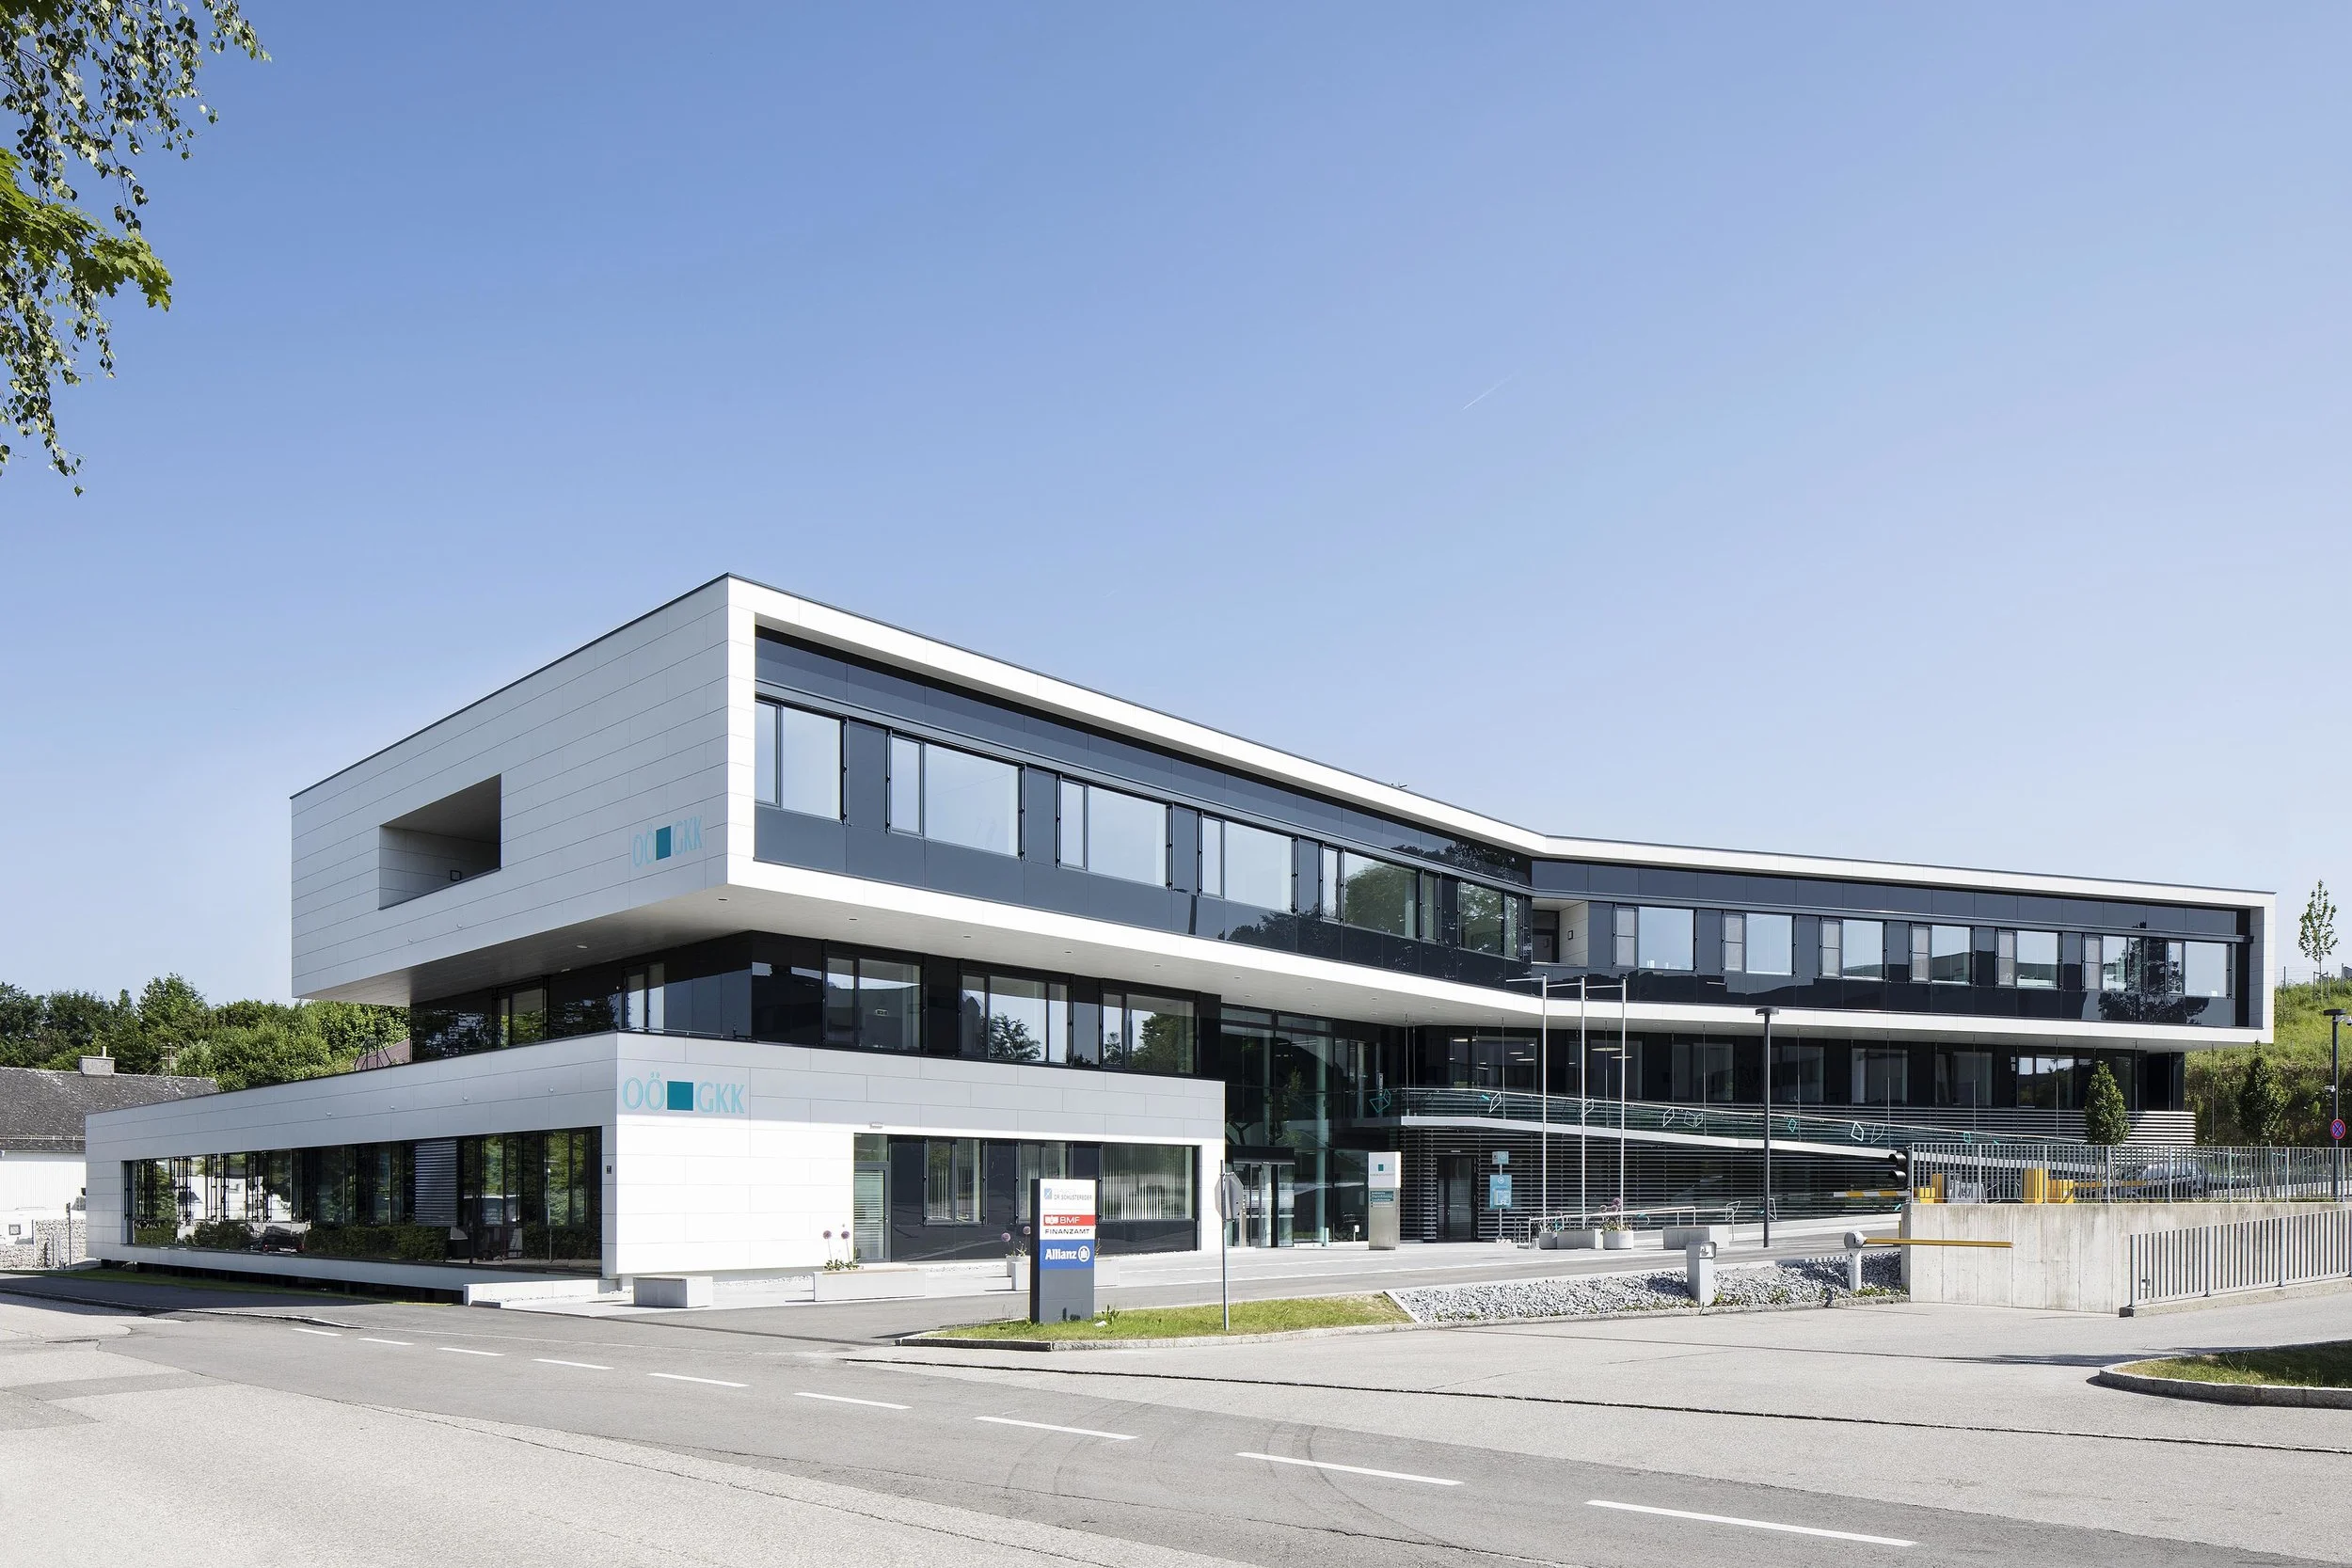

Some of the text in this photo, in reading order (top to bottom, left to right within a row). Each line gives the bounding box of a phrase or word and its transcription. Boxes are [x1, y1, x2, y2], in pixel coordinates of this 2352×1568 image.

[632, 815, 703, 868] OÖ GKK
[622, 1071, 746, 1115] OÖ GKK
[1044, 1248, 1077, 1260] Allianz
